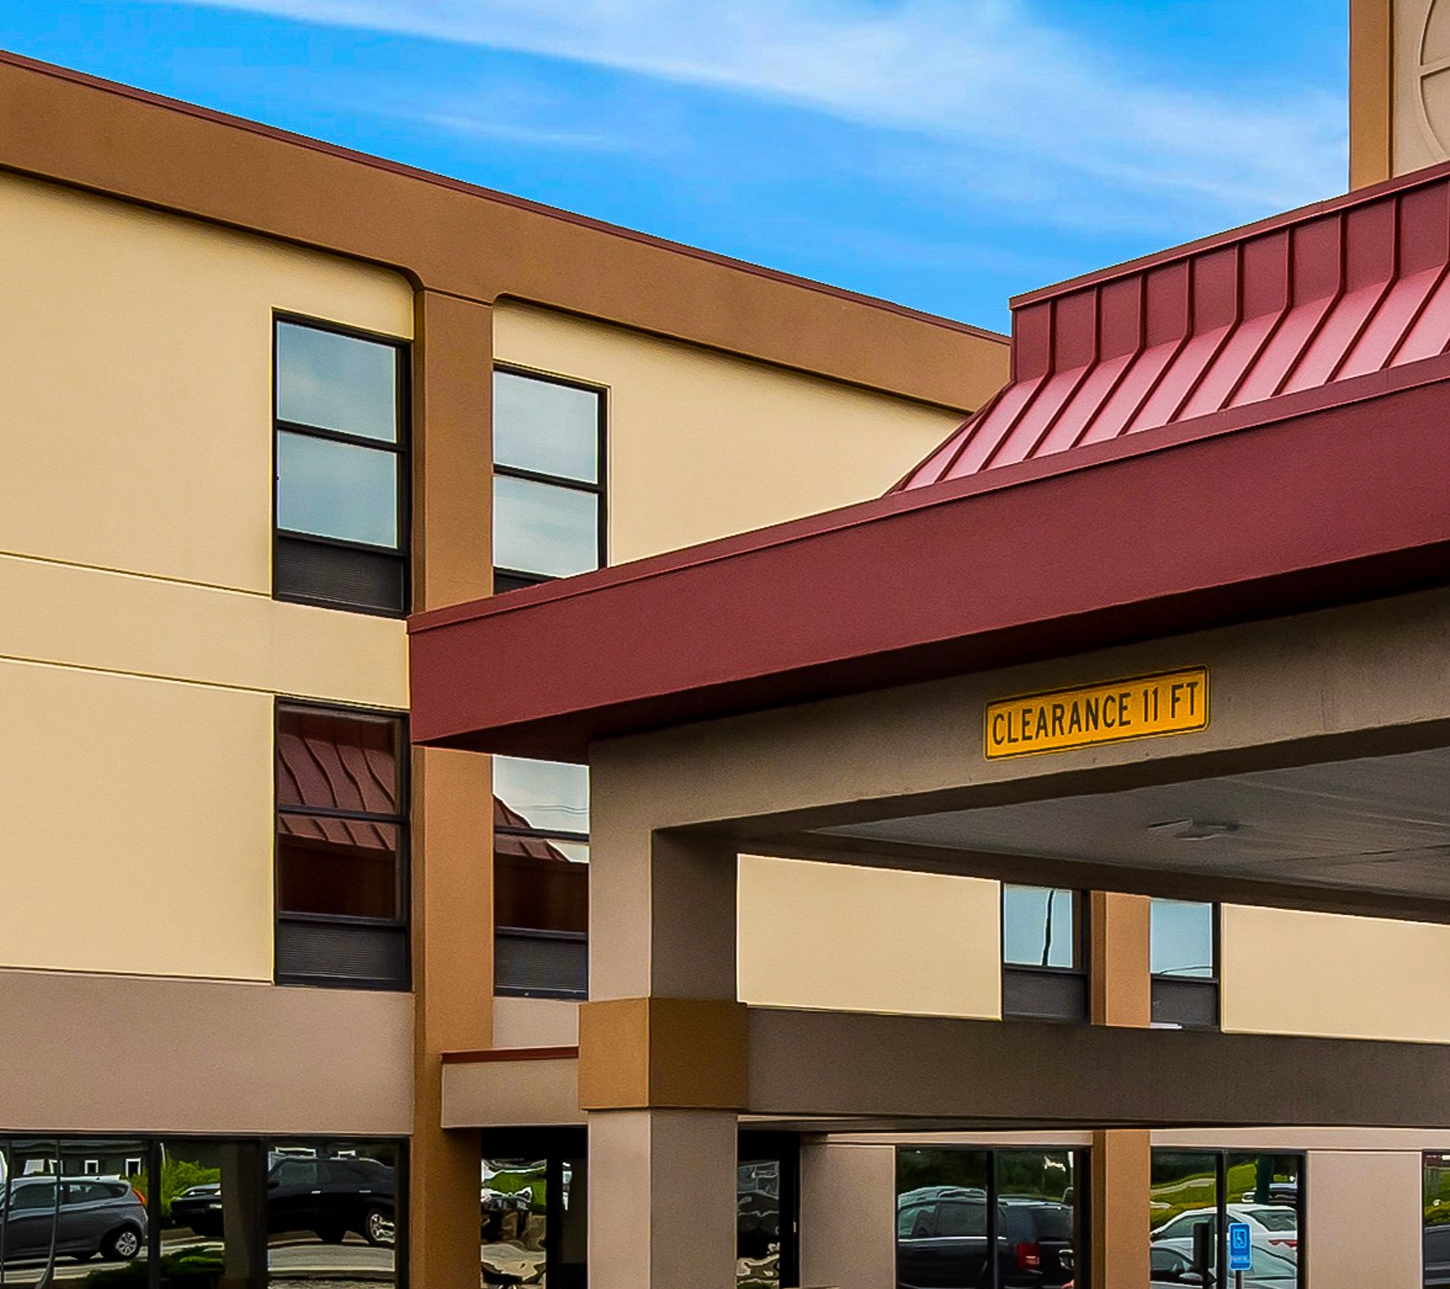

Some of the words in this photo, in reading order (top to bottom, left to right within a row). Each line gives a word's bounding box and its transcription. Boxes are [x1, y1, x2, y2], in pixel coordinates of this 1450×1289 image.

[993, 692, 1131, 745] CLEARANCE
[1143, 687, 1158, 722] 11
[1171, 682, 1198, 718] FT
